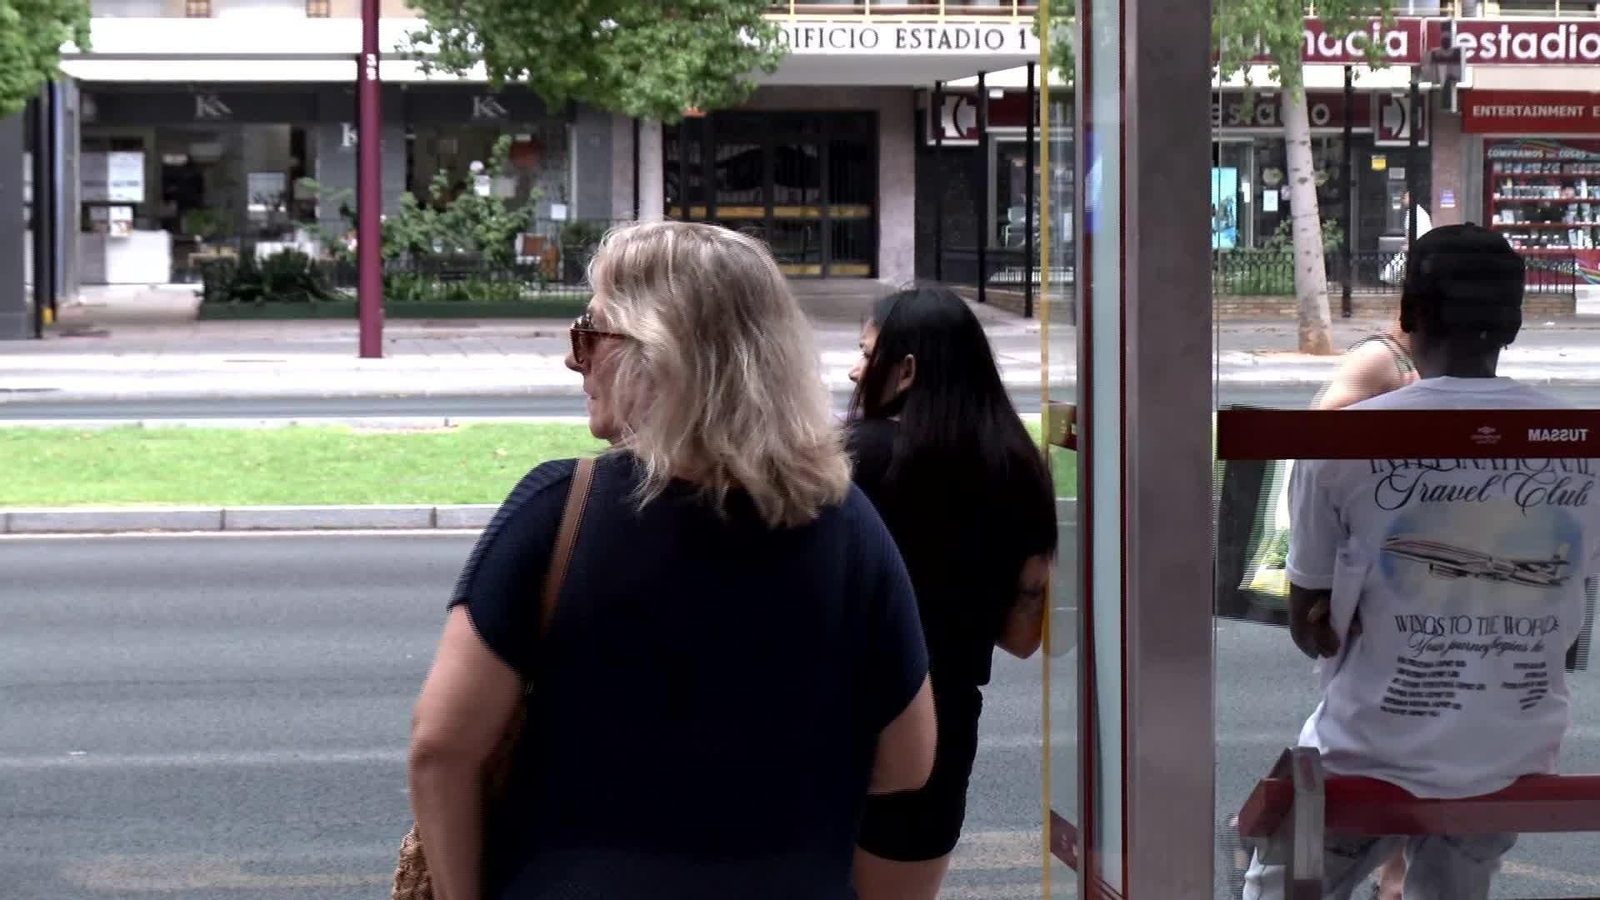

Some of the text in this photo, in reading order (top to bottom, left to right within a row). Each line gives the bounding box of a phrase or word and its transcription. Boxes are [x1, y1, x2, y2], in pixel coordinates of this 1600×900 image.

[775, 27, 1027, 50] DIFICIO ESTADIO 1
[1455, 24, 1600, 59] estadio
[1472, 105, 1586, 118] ENTERTAINMENT
[1375, 463, 1595, 518] Travel Club
[1449, 614, 1473, 635] TO
